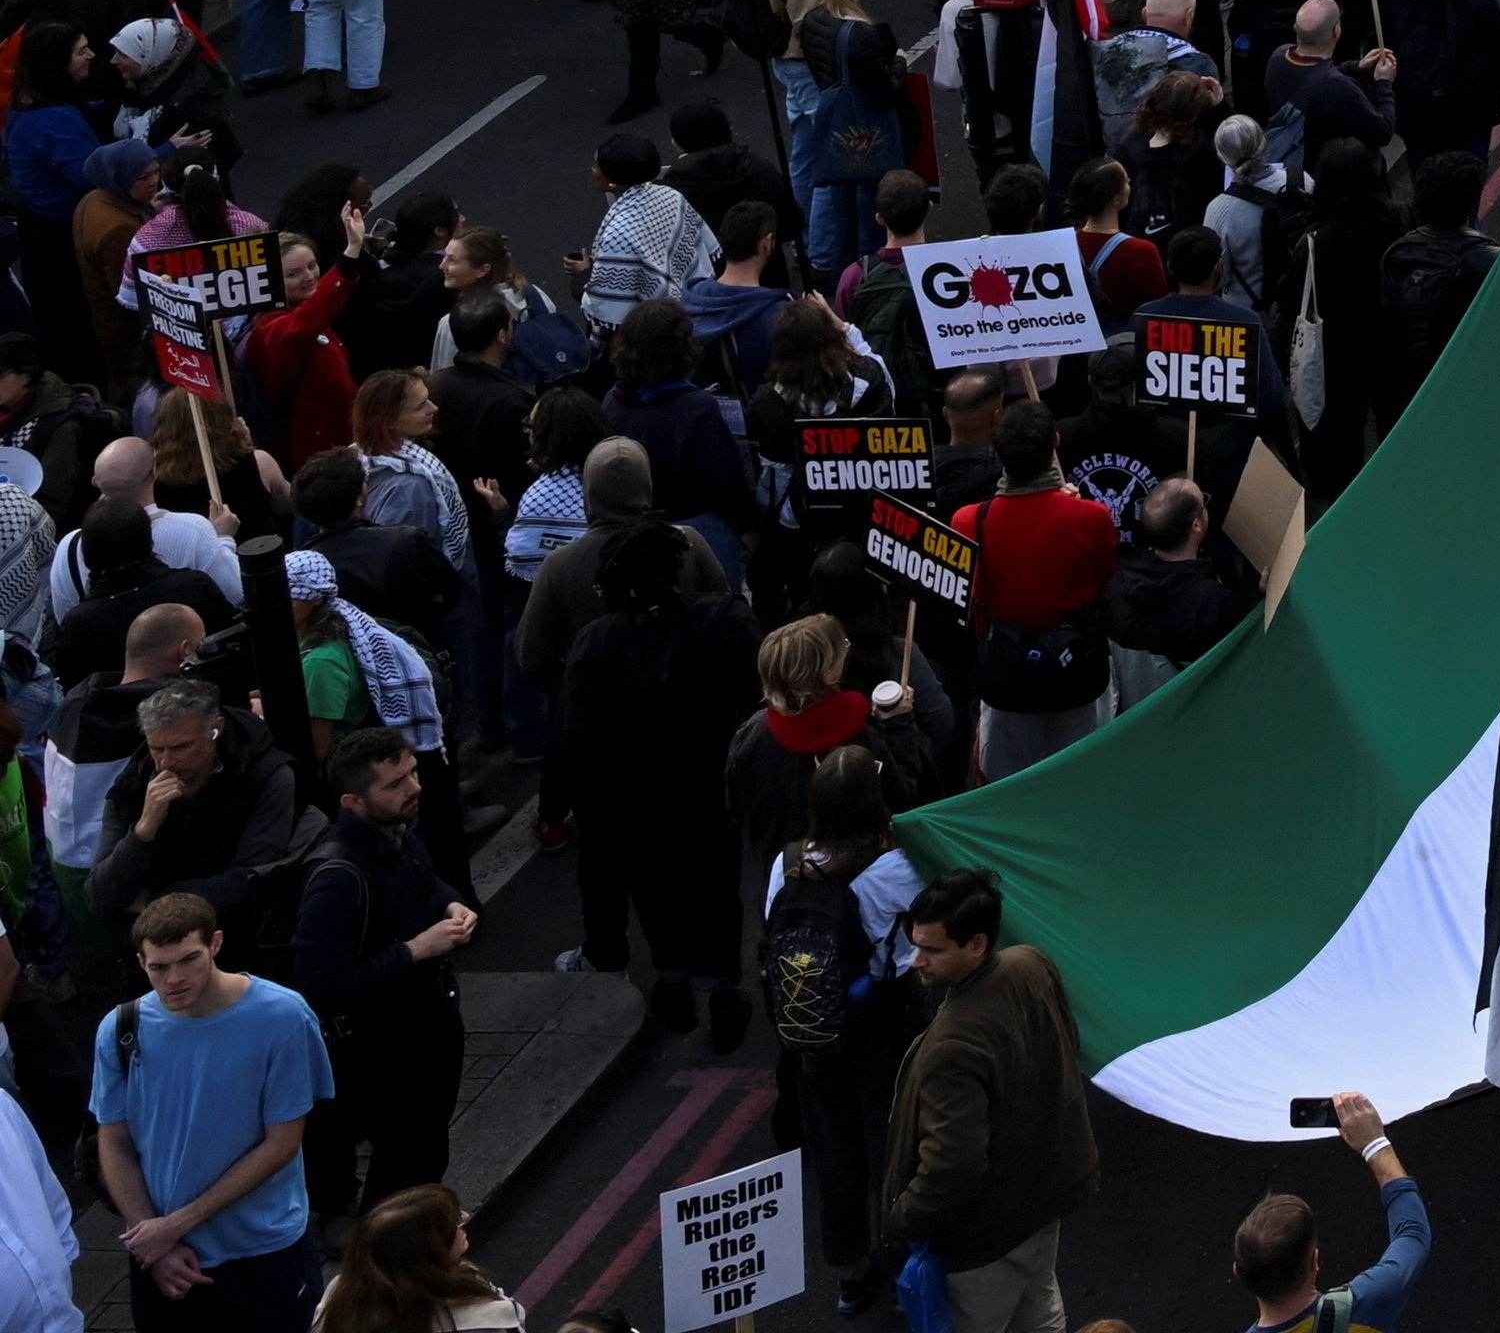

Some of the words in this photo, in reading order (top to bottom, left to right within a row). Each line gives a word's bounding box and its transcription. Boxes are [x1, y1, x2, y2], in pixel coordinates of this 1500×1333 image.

[921, 261, 1074, 310] Gza
[937, 323, 974, 339] Stop
[977, 320, 1004, 338] the
[1008, 311, 1086, 339] genocide
[1147, 320, 1193, 353] END
[1201, 325, 1246, 358] THE
[1145, 351, 1246, 404] SIEGE
[803, 429, 860, 453] STOP
[867, 427, 927, 453] GAZA
[805, 460, 932, 490] GENOCIDE
[676, 1171, 784, 1223] Muslim
[684, 1198, 779, 1246] Rulers
[708, 1233, 757, 1264] the
[701, 1250, 767, 1292] Real
[714, 1282, 757, 1316] IDF
